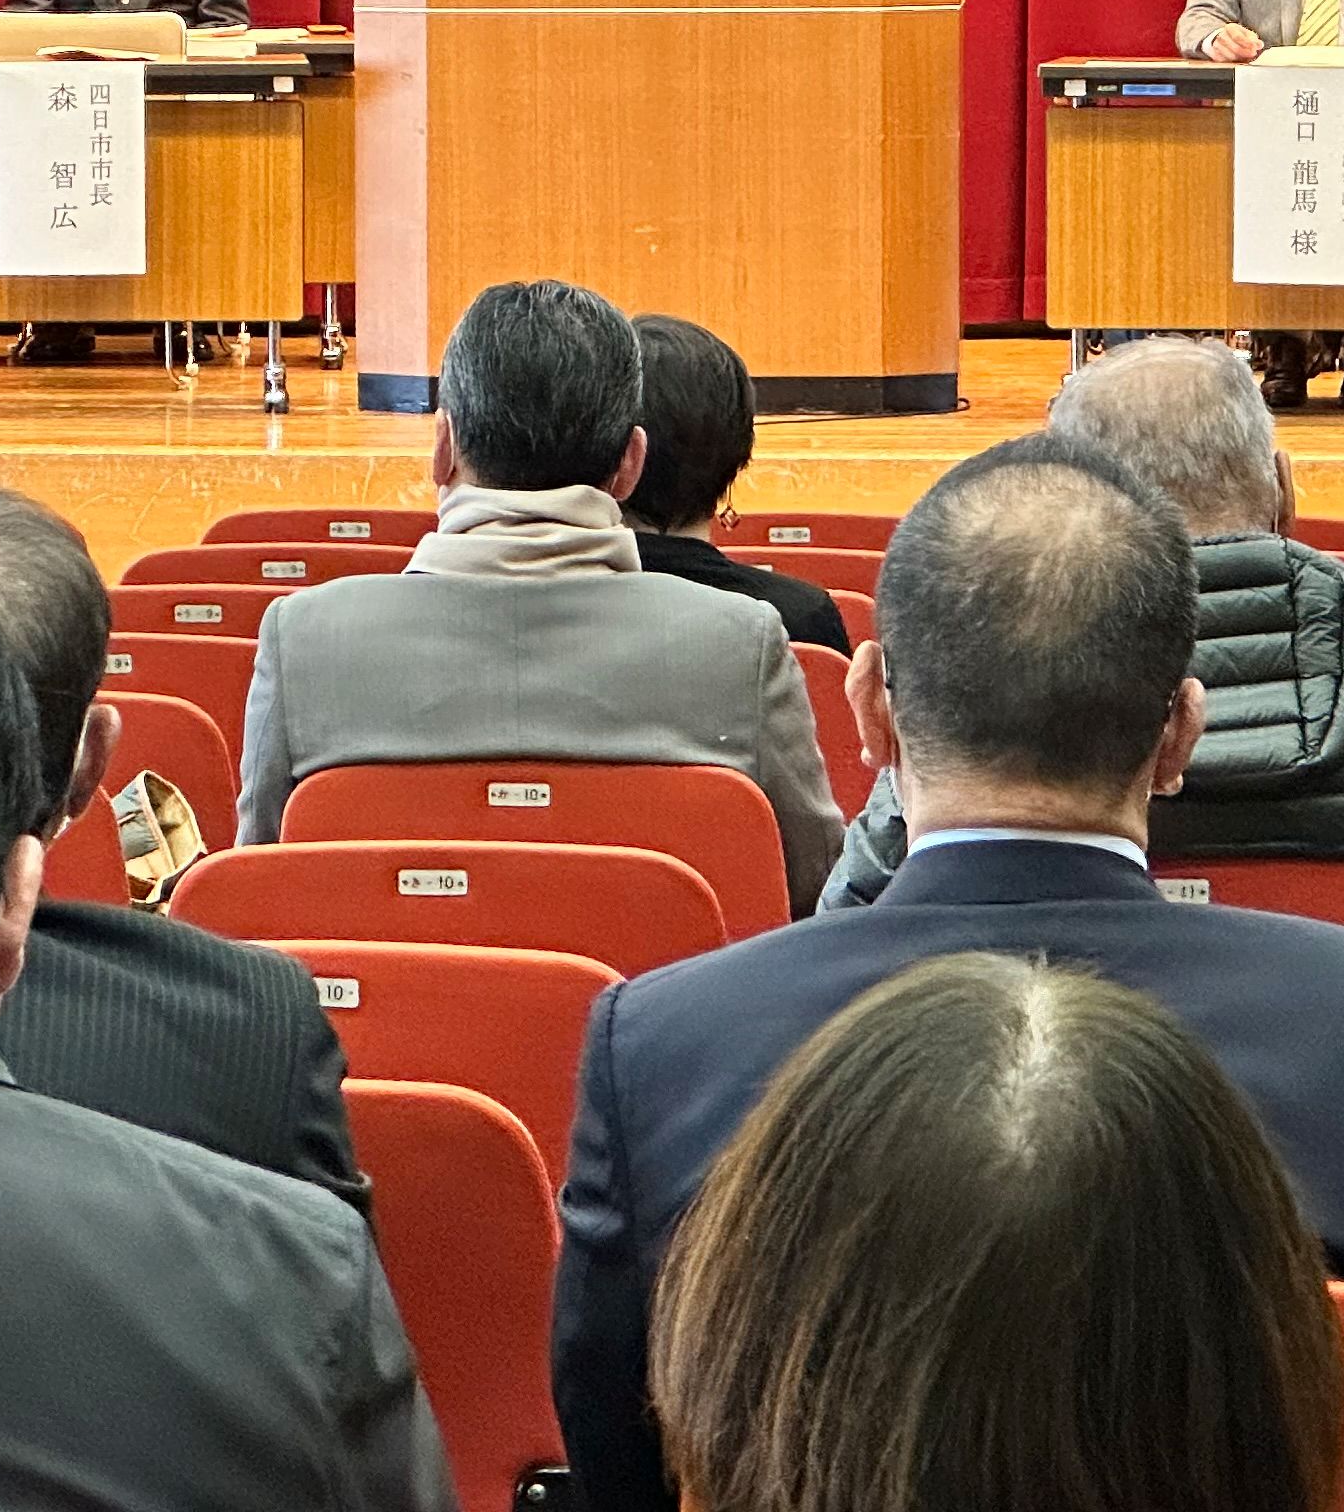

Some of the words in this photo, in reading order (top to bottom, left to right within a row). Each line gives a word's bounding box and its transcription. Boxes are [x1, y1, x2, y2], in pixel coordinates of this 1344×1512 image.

[1292, 89, 1320, 142] 樋口
[89, 84, 113, 207] 四日市市長
[1290, 229, 1318, 256] 様
